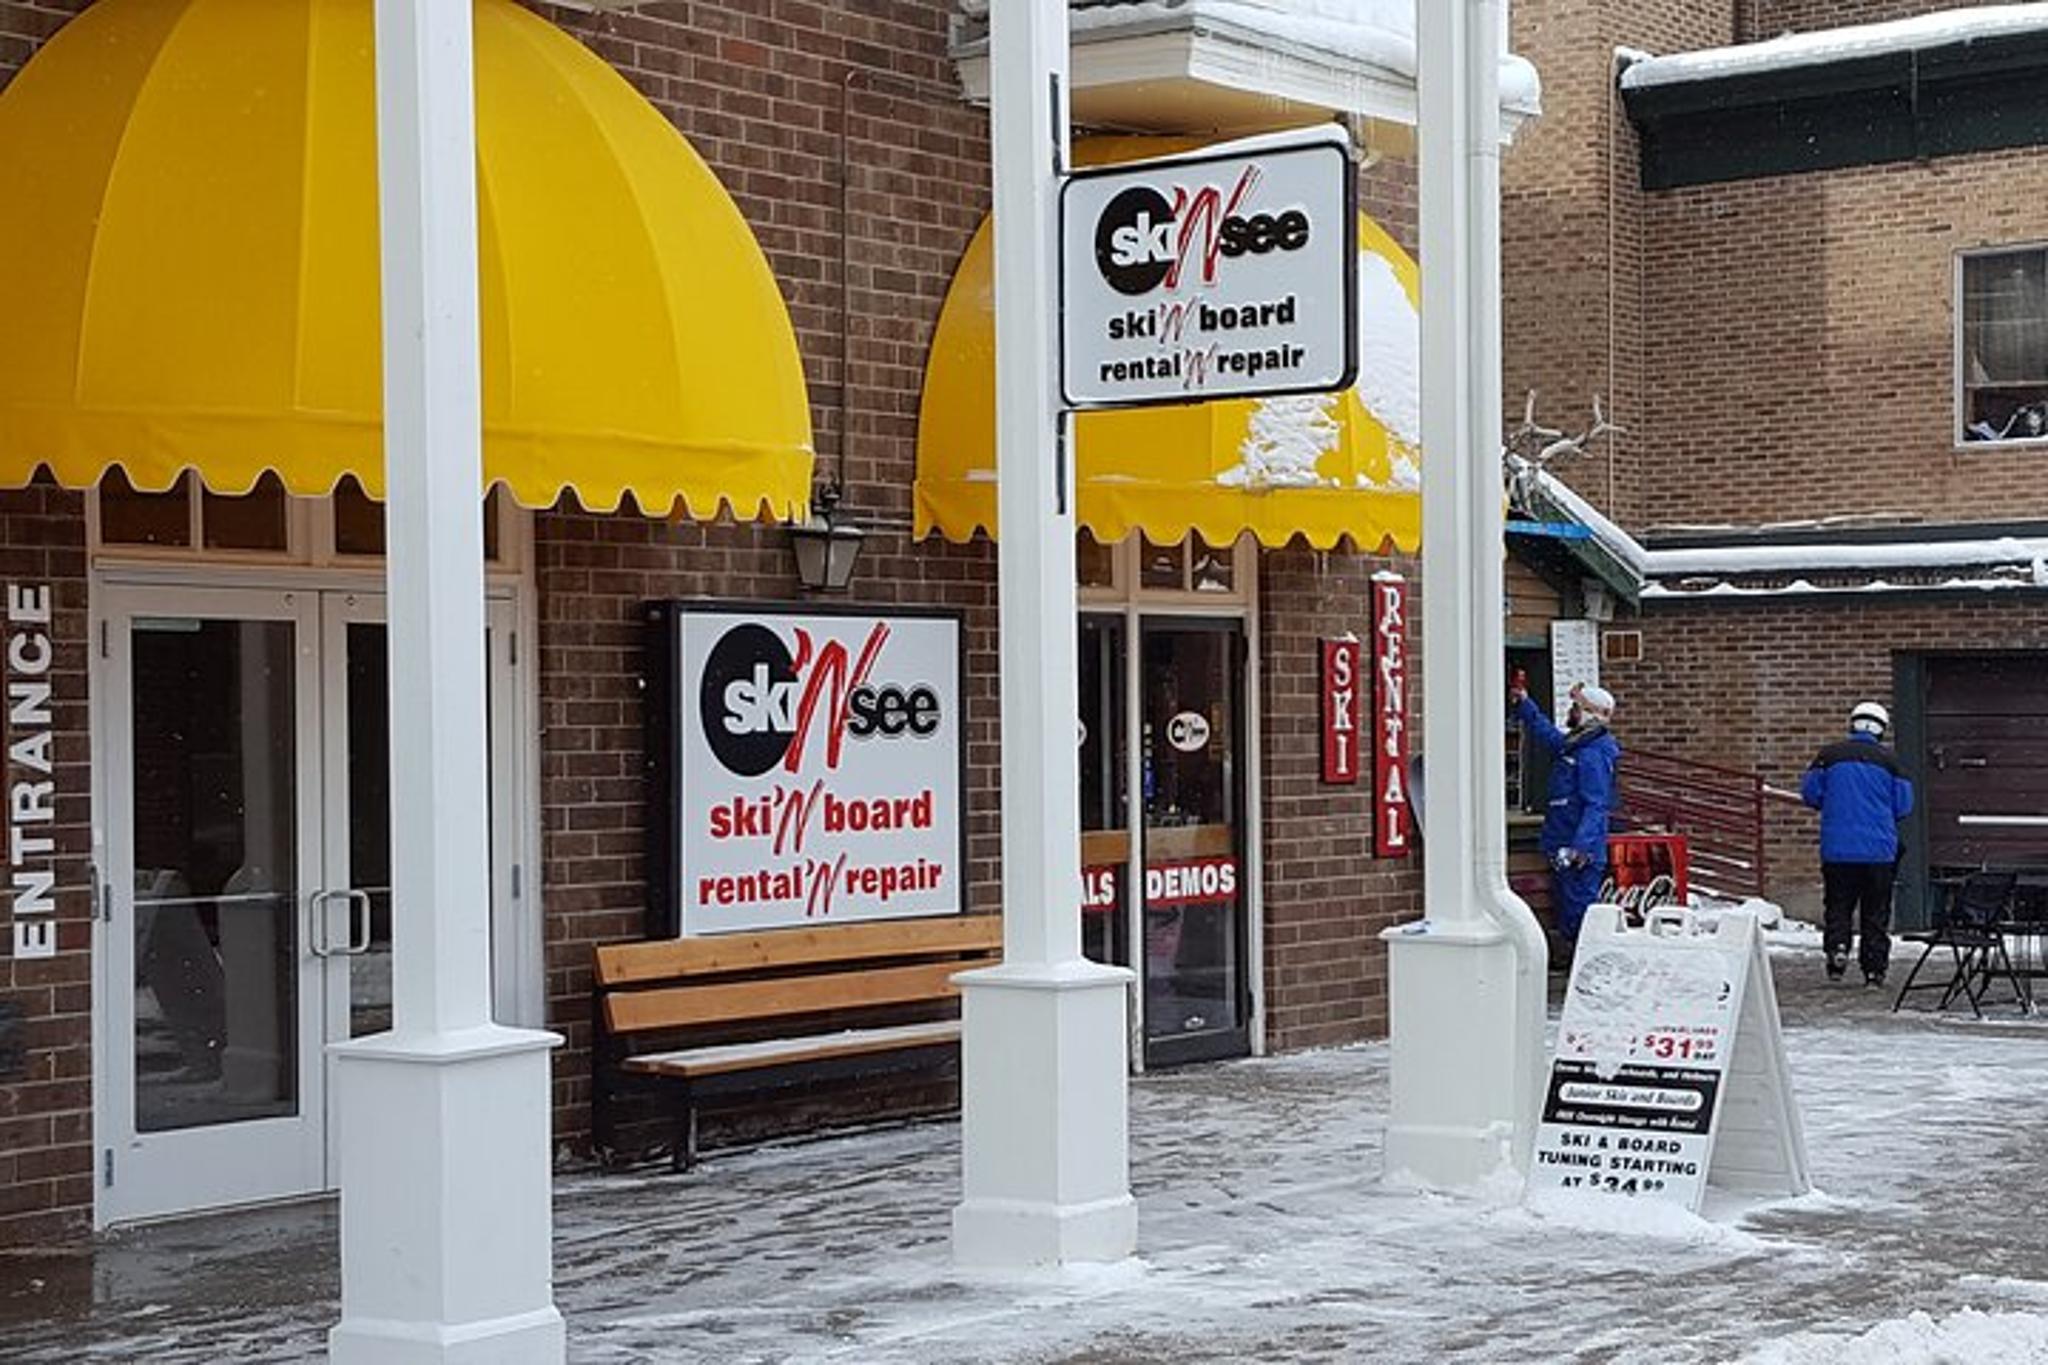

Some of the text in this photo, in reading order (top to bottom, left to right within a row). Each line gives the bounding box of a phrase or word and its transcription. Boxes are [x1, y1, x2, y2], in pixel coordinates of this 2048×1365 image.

[1200, 296, 1295, 332] board
[1217, 344, 1304, 377] repair
[1333, 647, 1352, 775] SKI
[1380, 586, 1405, 846] RENTAL
[8, 584, 57, 959] ENTRANCE
[824, 790, 932, 832] board
[846, 858, 942, 901] repair
[1146, 863, 1236, 900] DEMOS
[1560, 1132, 1682, 1154] SKI & BOARD
[1538, 1150, 1698, 1176] TUNING STARTING
[1560, 1176, 1583, 1187] AT
